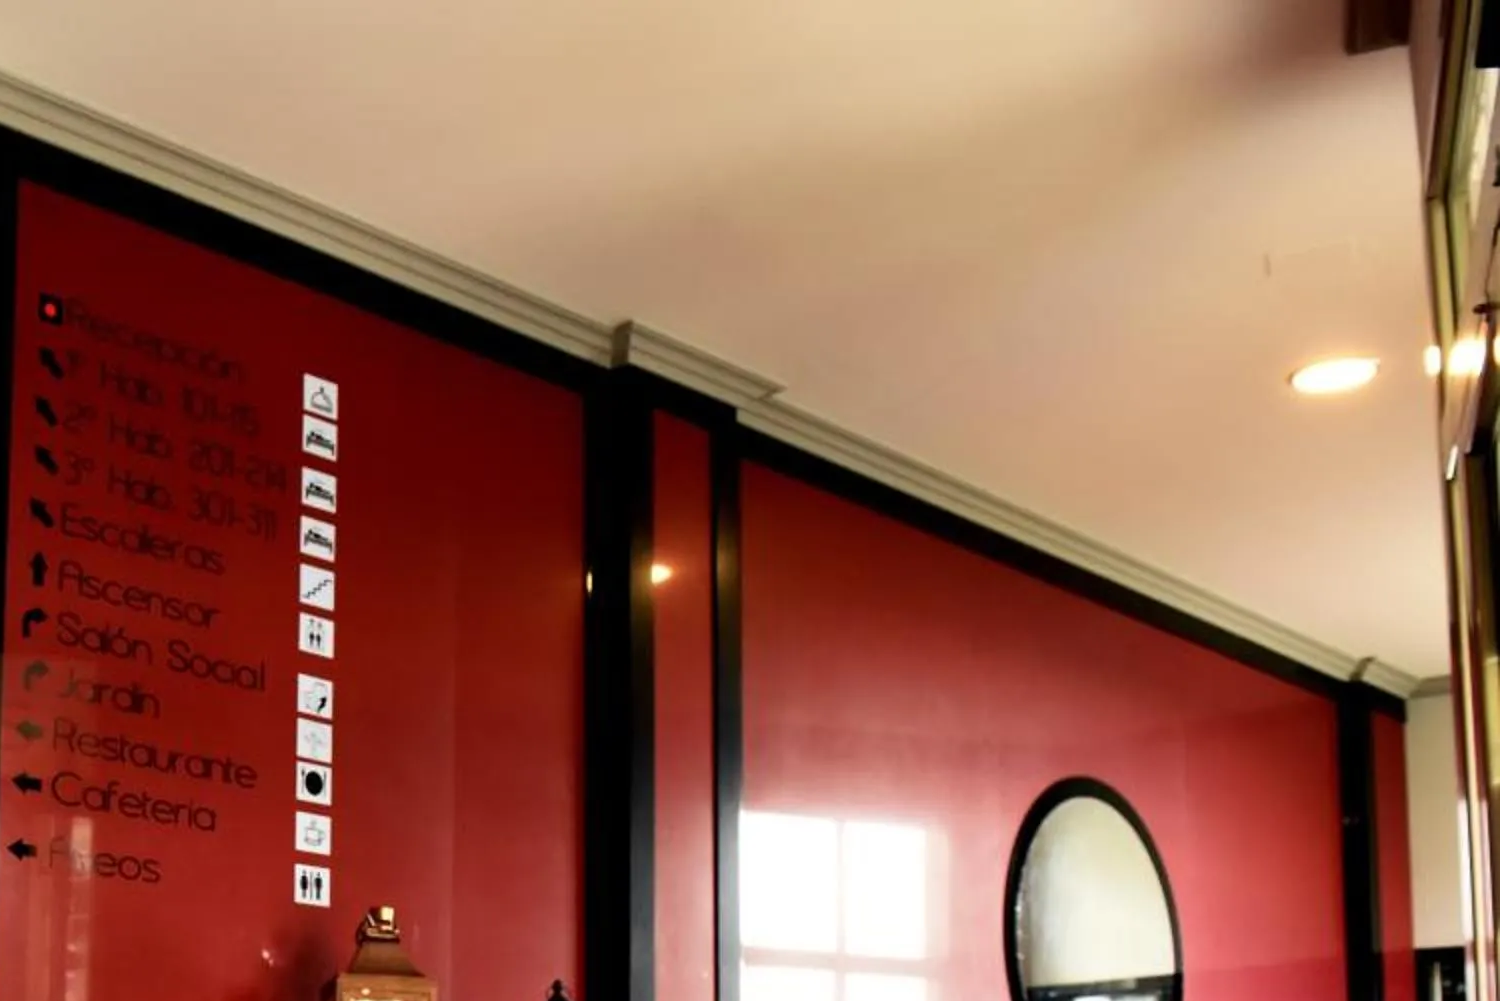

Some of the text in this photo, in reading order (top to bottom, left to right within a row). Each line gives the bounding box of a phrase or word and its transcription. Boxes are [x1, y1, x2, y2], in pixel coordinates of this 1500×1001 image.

[60, 501, 227, 577] Escaleras
[56, 558, 221, 630] Ascensor
[166, 638, 266, 692] Social
[52, 717, 258, 790] Restaurante
